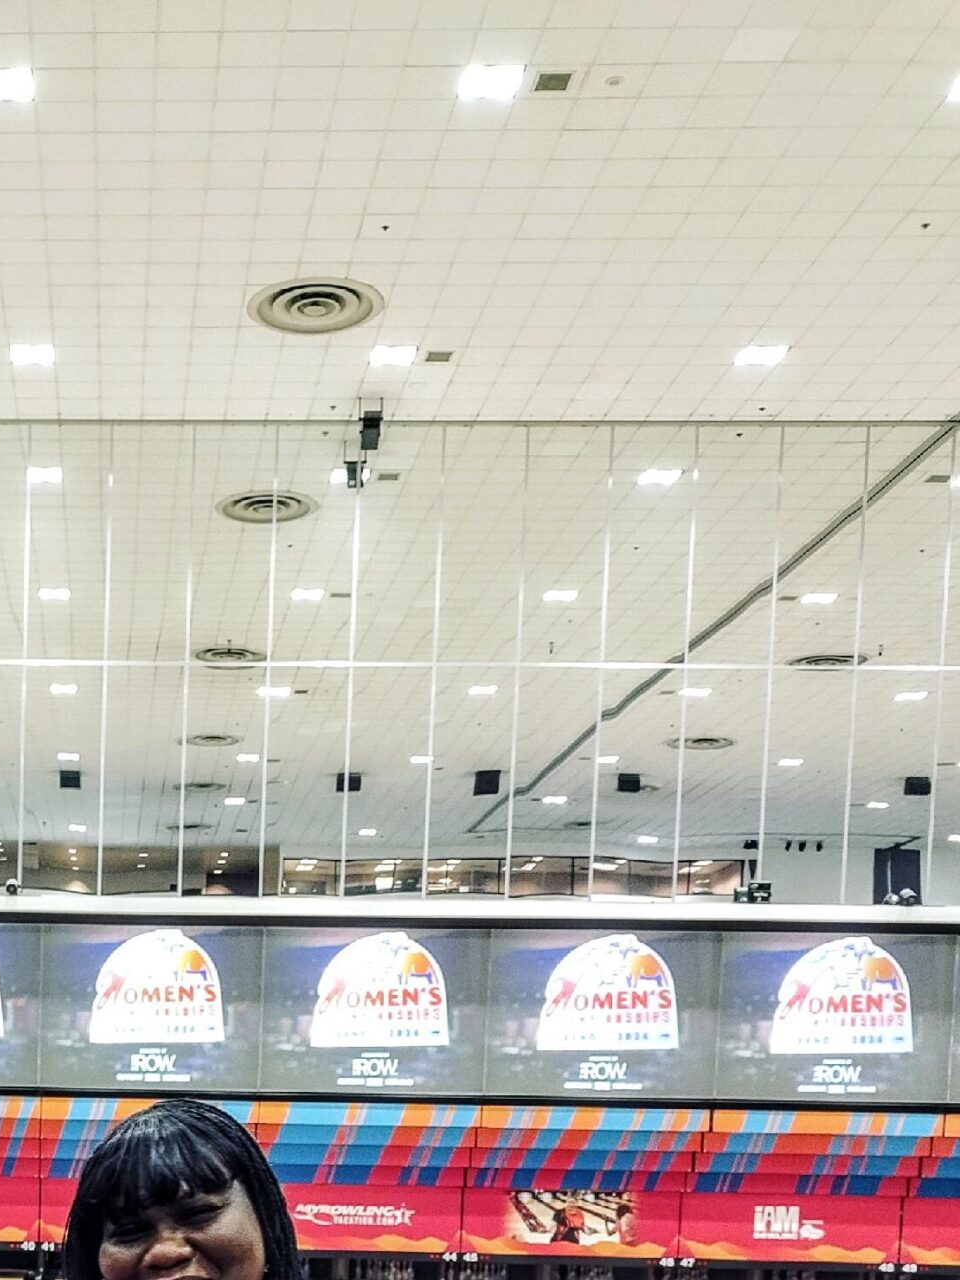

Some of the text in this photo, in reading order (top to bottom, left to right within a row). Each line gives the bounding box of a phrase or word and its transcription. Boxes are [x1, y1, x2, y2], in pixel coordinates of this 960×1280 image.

[20, 1240, 37, 1251] 40
[40, 1240, 55, 1252] 41
[442, 1251, 458, 1262] 44
[680, 1257, 696, 1268] 47
